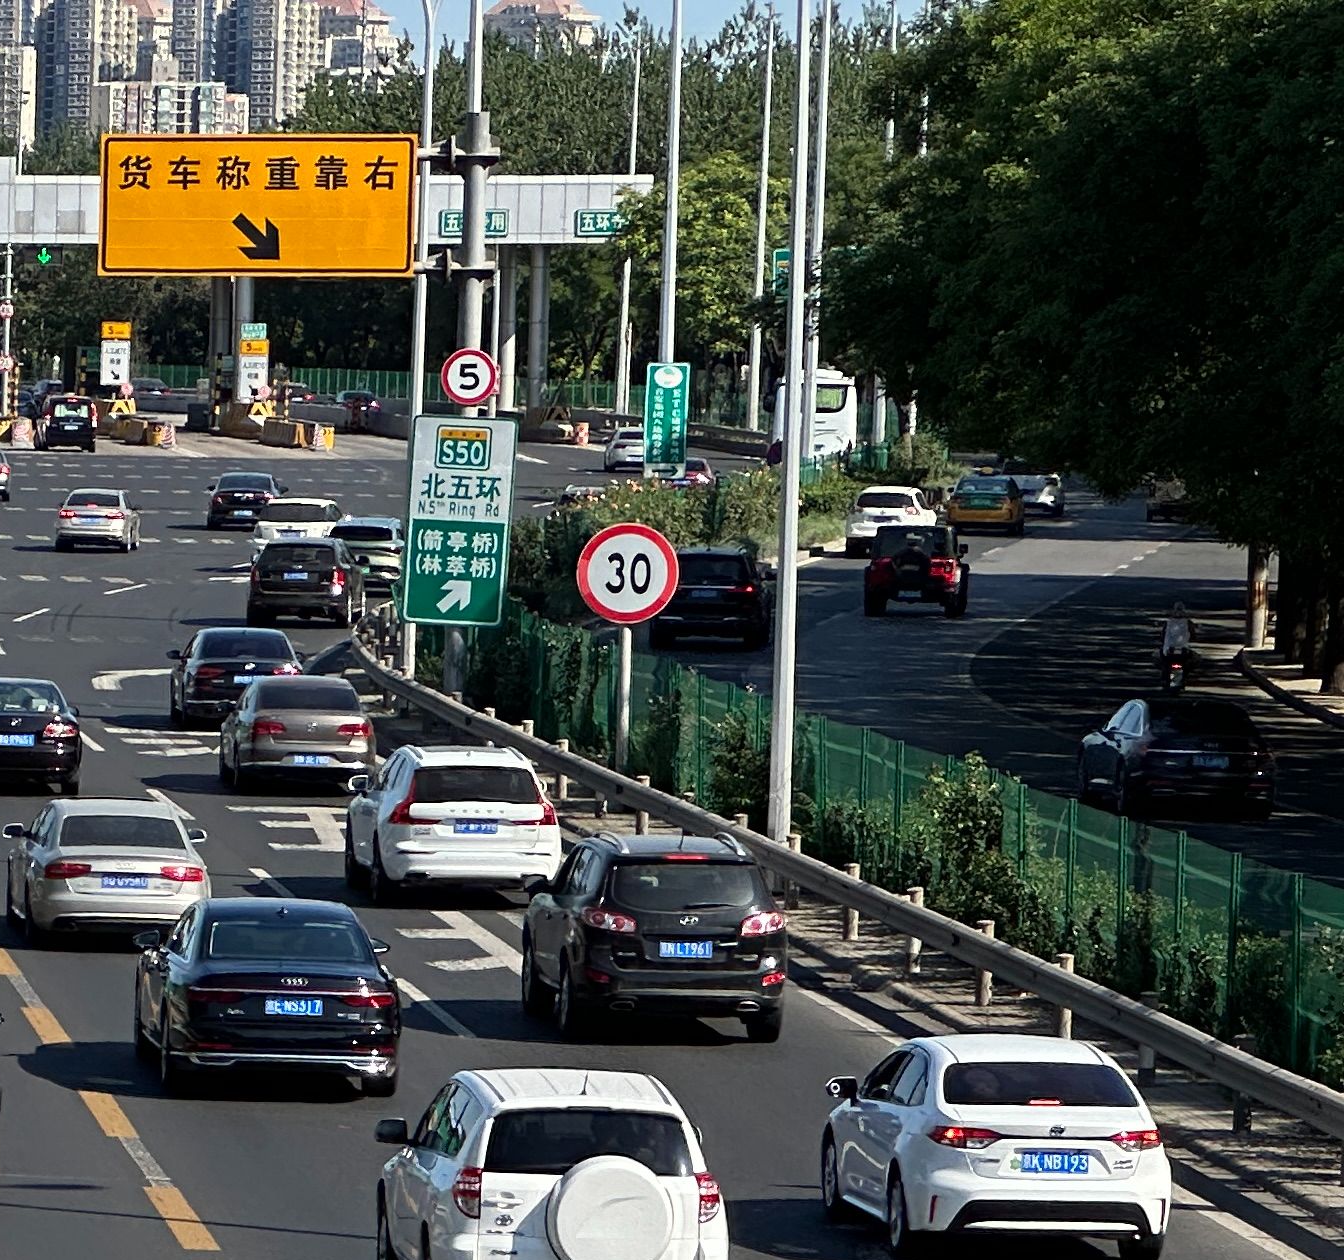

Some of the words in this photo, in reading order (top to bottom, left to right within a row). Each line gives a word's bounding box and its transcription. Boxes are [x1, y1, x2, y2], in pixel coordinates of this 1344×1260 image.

[118, 155, 399, 191] 货车称重靠右
[446, 213, 506, 231] 五用
[458, 364, 480, 391] 5
[441, 439, 484, 466] S50
[420, 473, 502, 502] 北五环
[449, 501, 475, 519] Ring
[485, 502, 500, 518] Rd
[417, 528, 499, 556] (箭亭桥)
[415, 553, 497, 579] (林萃桥)
[605, 552, 651, 595] 30
